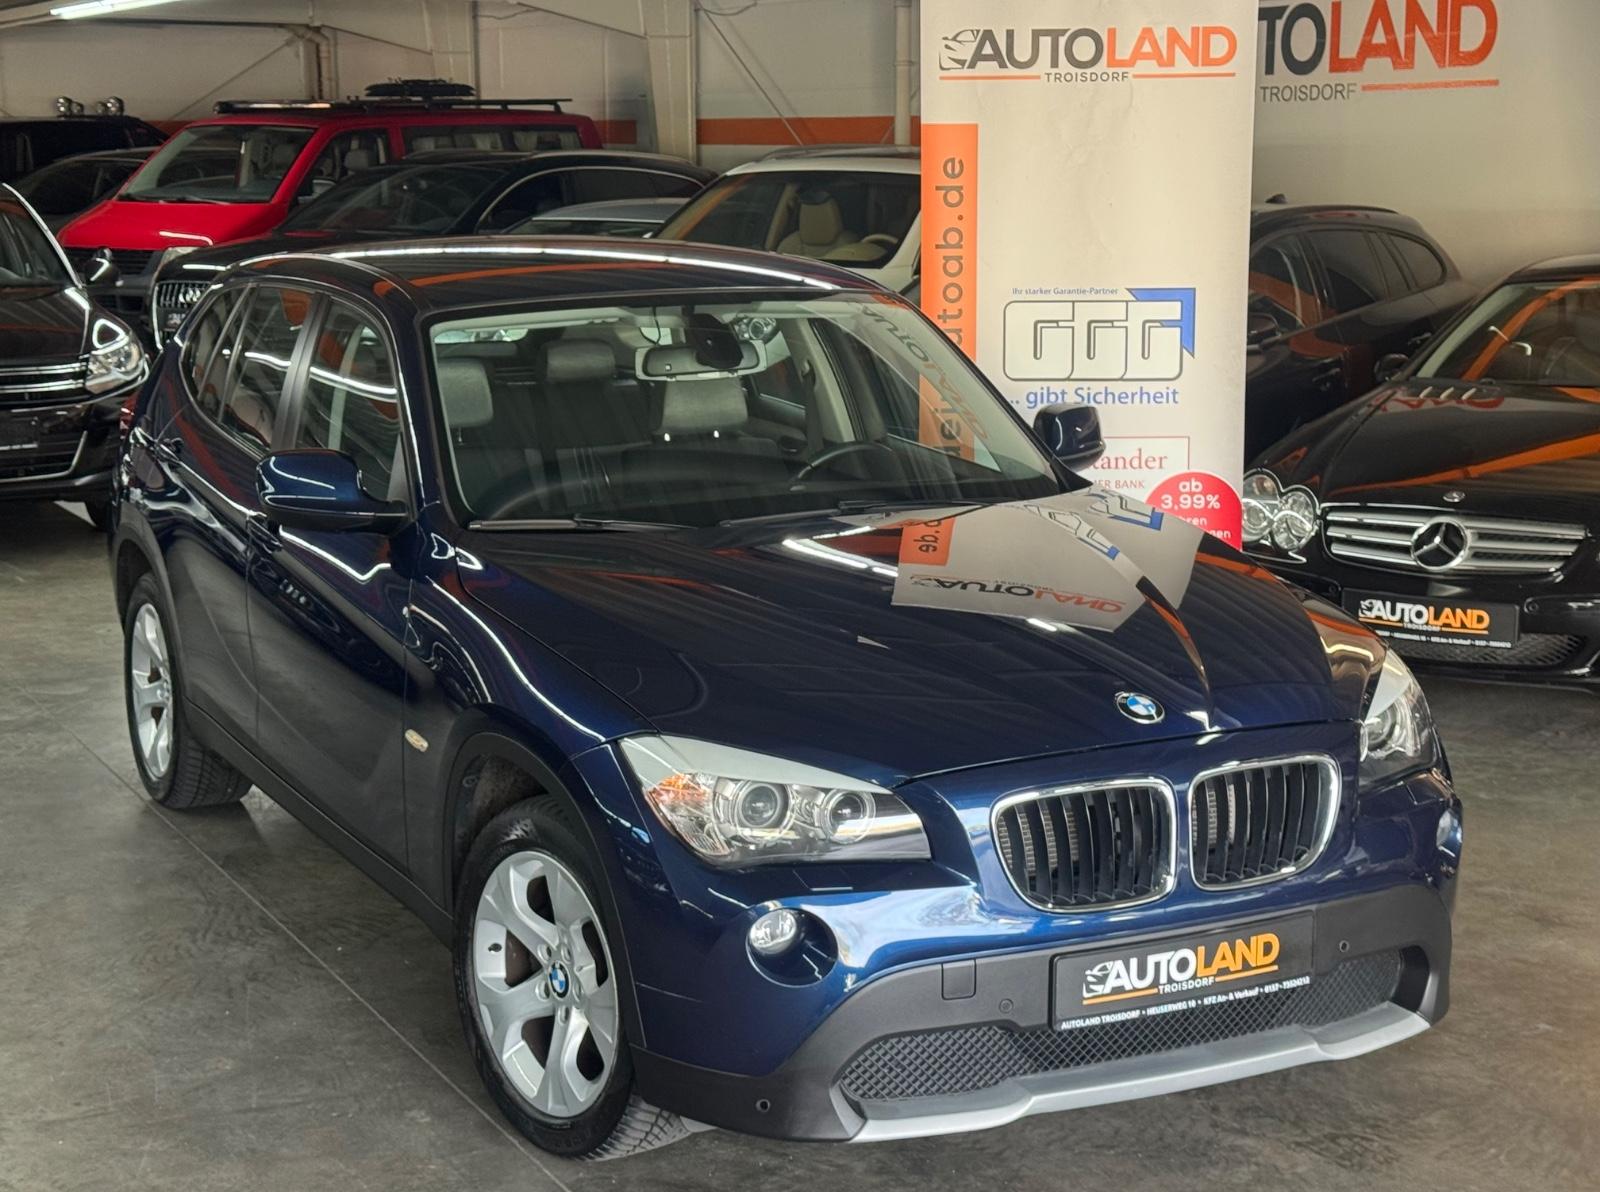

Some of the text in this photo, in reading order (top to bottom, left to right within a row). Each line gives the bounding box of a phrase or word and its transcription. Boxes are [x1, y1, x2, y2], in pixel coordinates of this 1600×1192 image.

[966, 26, 1237, 69] AUTOLAND
[1257, 0, 1498, 75] TOLAND
[1045, 71, 1130, 83] TROISDORF
[1259, 83, 1358, 102] TROISDORF
[1012, 287, 1119, 295] Ihr starker Garantie-Partner
[1025, 386, 1068, 410] gibt
[1074, 386, 1179, 405] Sicherheit
[1093, 448, 1168, 470] tander
[1114, 479, 1145, 489] BANK
[1179, 478, 1203, 492] ab
[1371, 600, 1490, 630] AUTOLAND
[1102, 933, 1280, 994] AUTOLAND
[1158, 976, 1215, 995] TROISDORF
[1061, 1015, 1101, 1030] AUTOLAND
[1101, 1009, 1140, 1024] TROISDORF
